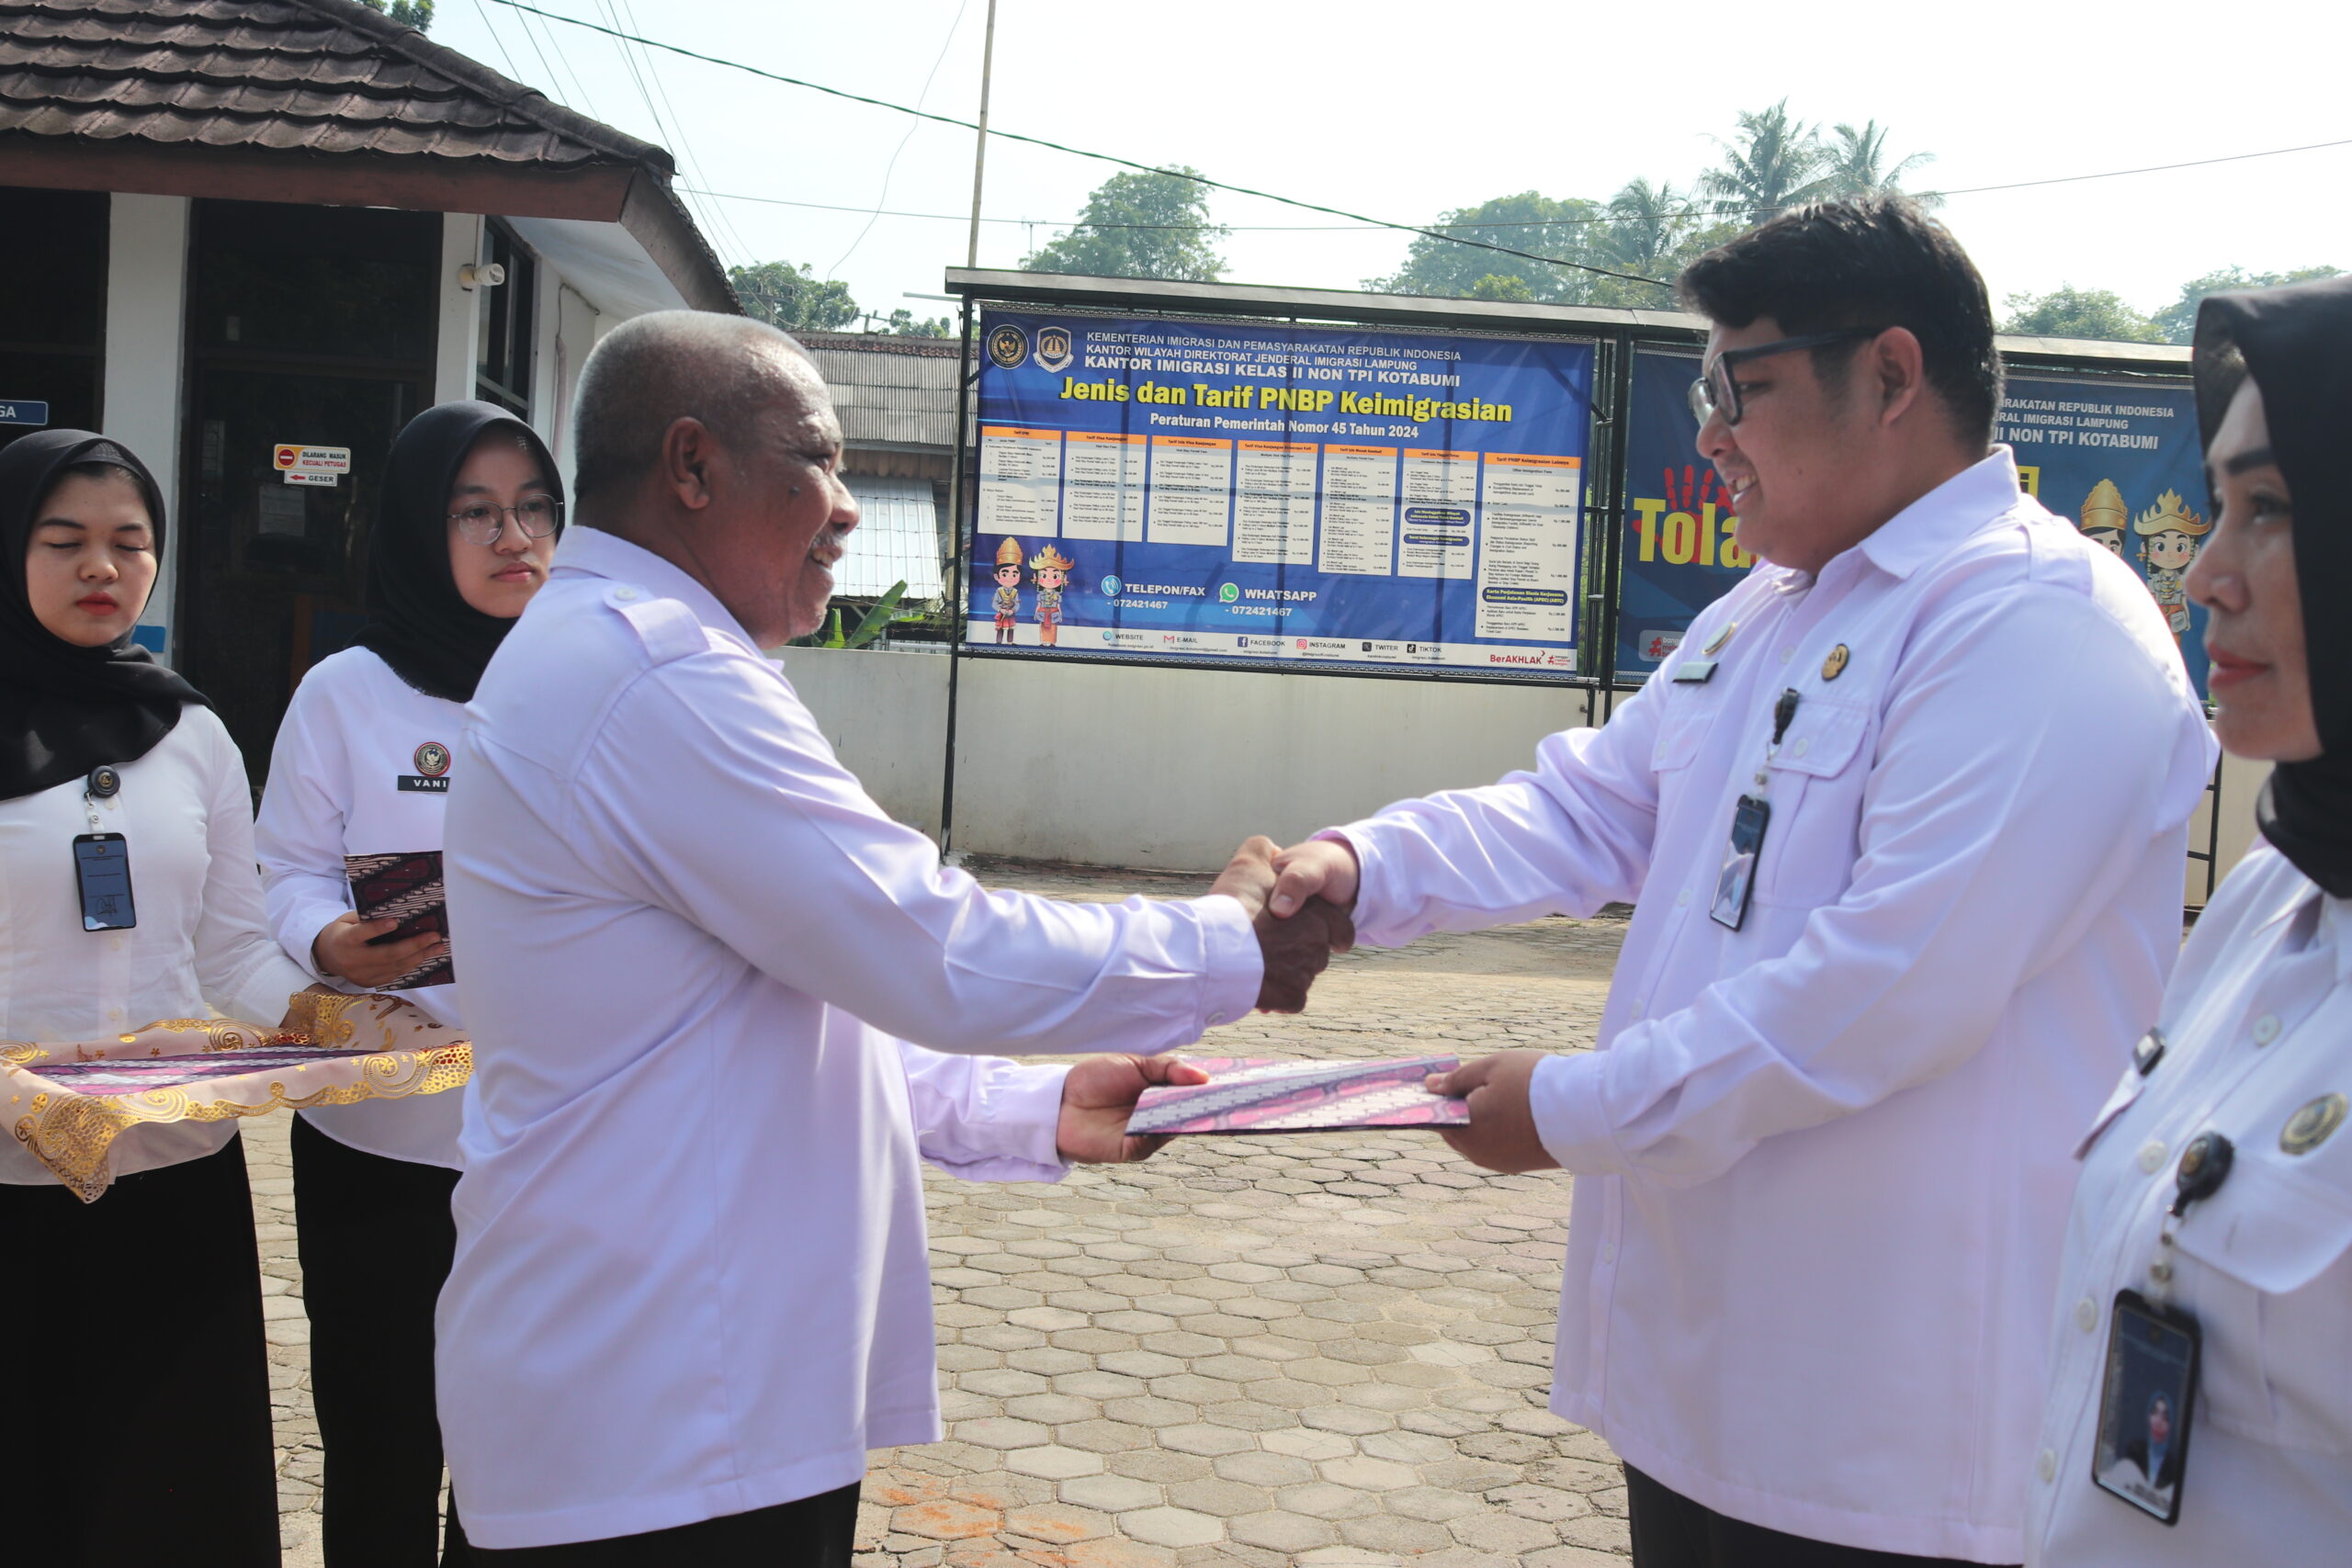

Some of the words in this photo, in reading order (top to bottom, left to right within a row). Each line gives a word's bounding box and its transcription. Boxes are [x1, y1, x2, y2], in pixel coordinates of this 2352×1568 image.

[1087, 332, 1164, 344] KEMENTERIAN
[1167, 336, 1215, 347] IMIGRASI
[1217, 339, 1240, 349] DAN
[1244, 341, 1345, 355] PEMASYARAKATAN
[1348, 345, 1400, 357] REPUBLIK
[1403, 348, 1461, 360] INDONESIA
[1086, 344, 1132, 355] KANTOR
[1134, 346, 1182, 358] WILAYAH
[1184, 349, 1252, 362] DIREKTORAT
[1255, 353, 1312, 366] JENDERAL
[1315, 356, 1362, 367] IMIGRASI
[1364, 358, 1418, 371] LAMPUNG
[1084, 355, 1152, 370] KANTOR
[1157, 359, 1230, 375] IMIGRASI
[1235, 364, 1287, 378] KELAS
[1292, 367, 1303, 378] II
[1307, 367, 1343, 380] NON
[1348, 369, 1373, 382] TPI
[1377, 370, 1461, 387] KOTABUMI
[1060, 377, 1130, 402] Jenis
[1136, 380, 1186, 405] dan
[1193, 383, 1253, 410] Tarif
[1260, 386, 1334, 412] PNBP
[1340, 390, 1512, 423] Keimigrasian
[2058, 401, 2112, 415] REPUBLIK
[2115, 405, 2175, 418] INDONESIA
[1150, 412, 1211, 428] Peraturan
[1214, 416, 1285, 432] Pemerintah
[1288, 421, 1329, 434] Nomor
[1331, 422, 1347, 434] 45
[1349, 423, 1385, 436] Tahun
[1388, 424, 1419, 438] 2024
[2023, 413, 2074, 426] IMIGRASI
[2076, 417, 2130, 430] LAMPUNG
[2008, 427, 2043, 443] NON
[2048, 430, 2074, 445] TPI
[2078, 432, 2159, 450] KOTABUMI
[1634, 497, 1762, 569] Tola
[1125, 583, 1206, 596] TELEPON/FAX
[1245, 588, 1317, 602] WHATSAPP
[1113, 599, 1169, 610] 072421467
[1232, 605, 1293, 617] 072421467
[1308, 641, 1346, 649] INSTAGRAM
[1490, 654, 1544, 665] BerAKHLAK
[413, 779, 447, 788] VANI
